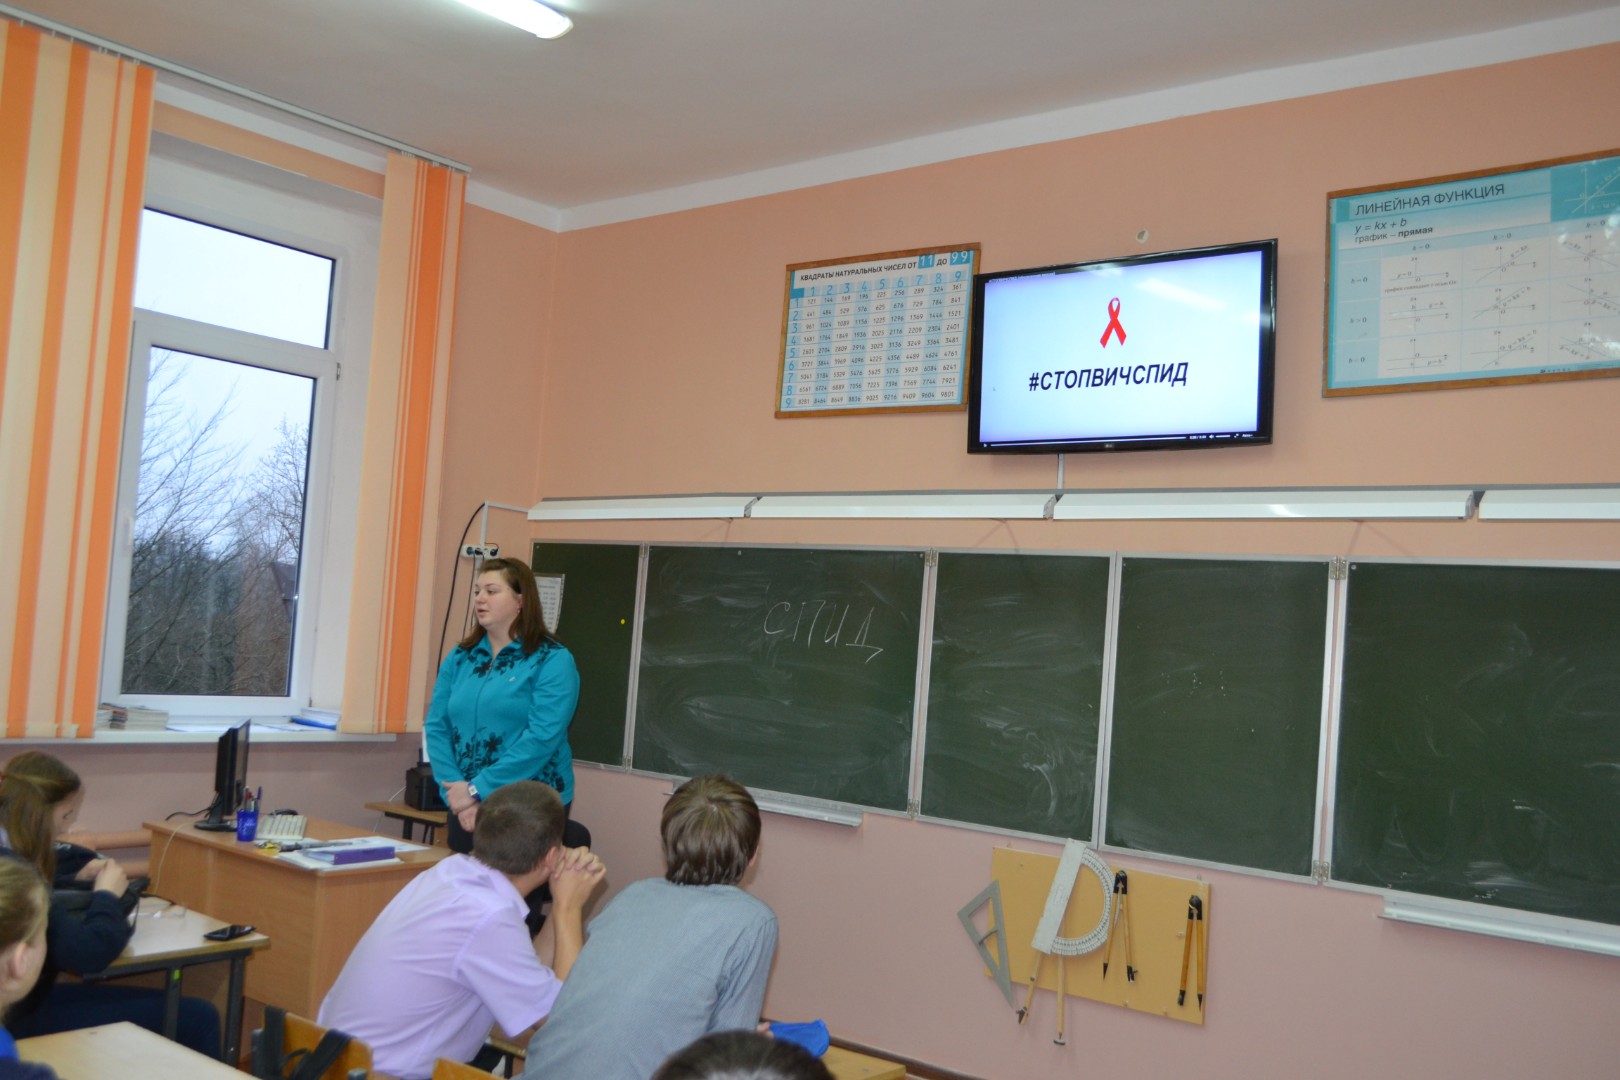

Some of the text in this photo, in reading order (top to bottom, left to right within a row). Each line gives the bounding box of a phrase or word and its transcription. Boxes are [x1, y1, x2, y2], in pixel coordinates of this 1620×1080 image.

[1355, 184, 1505, 215] ЛИНЕЙНАЯ ФУНКЦИЯ
[1374, 221, 1387, 230] kx
[1355, 233, 1388, 244] график
[1398, 227, 1433, 238] прямая
[800, 251, 968, 281] КВАДРАТЫ НАТУРАЛЬНЫХ ЧИСЕЛ ОТ 11 ДО 99
[811, 270, 962, 297] 1 2 3 4 5 6 7 8 9
[795, 298, 799, 308] 1
[793, 311, 799, 321] 2
[791, 336, 797, 345] 4
[946, 323, 960, 331] 2401
[792, 323, 798, 334] 3
[790, 347, 795, 358] 5
[788, 361, 795, 371] 6
[788, 373, 794, 383] 7
[1028, 362, 1189, 392] #СТОПВИЧСПИД
[786, 385, 793, 396] 8
[785, 398, 792, 408] 9
[764, 600, 884, 664] СПИД
